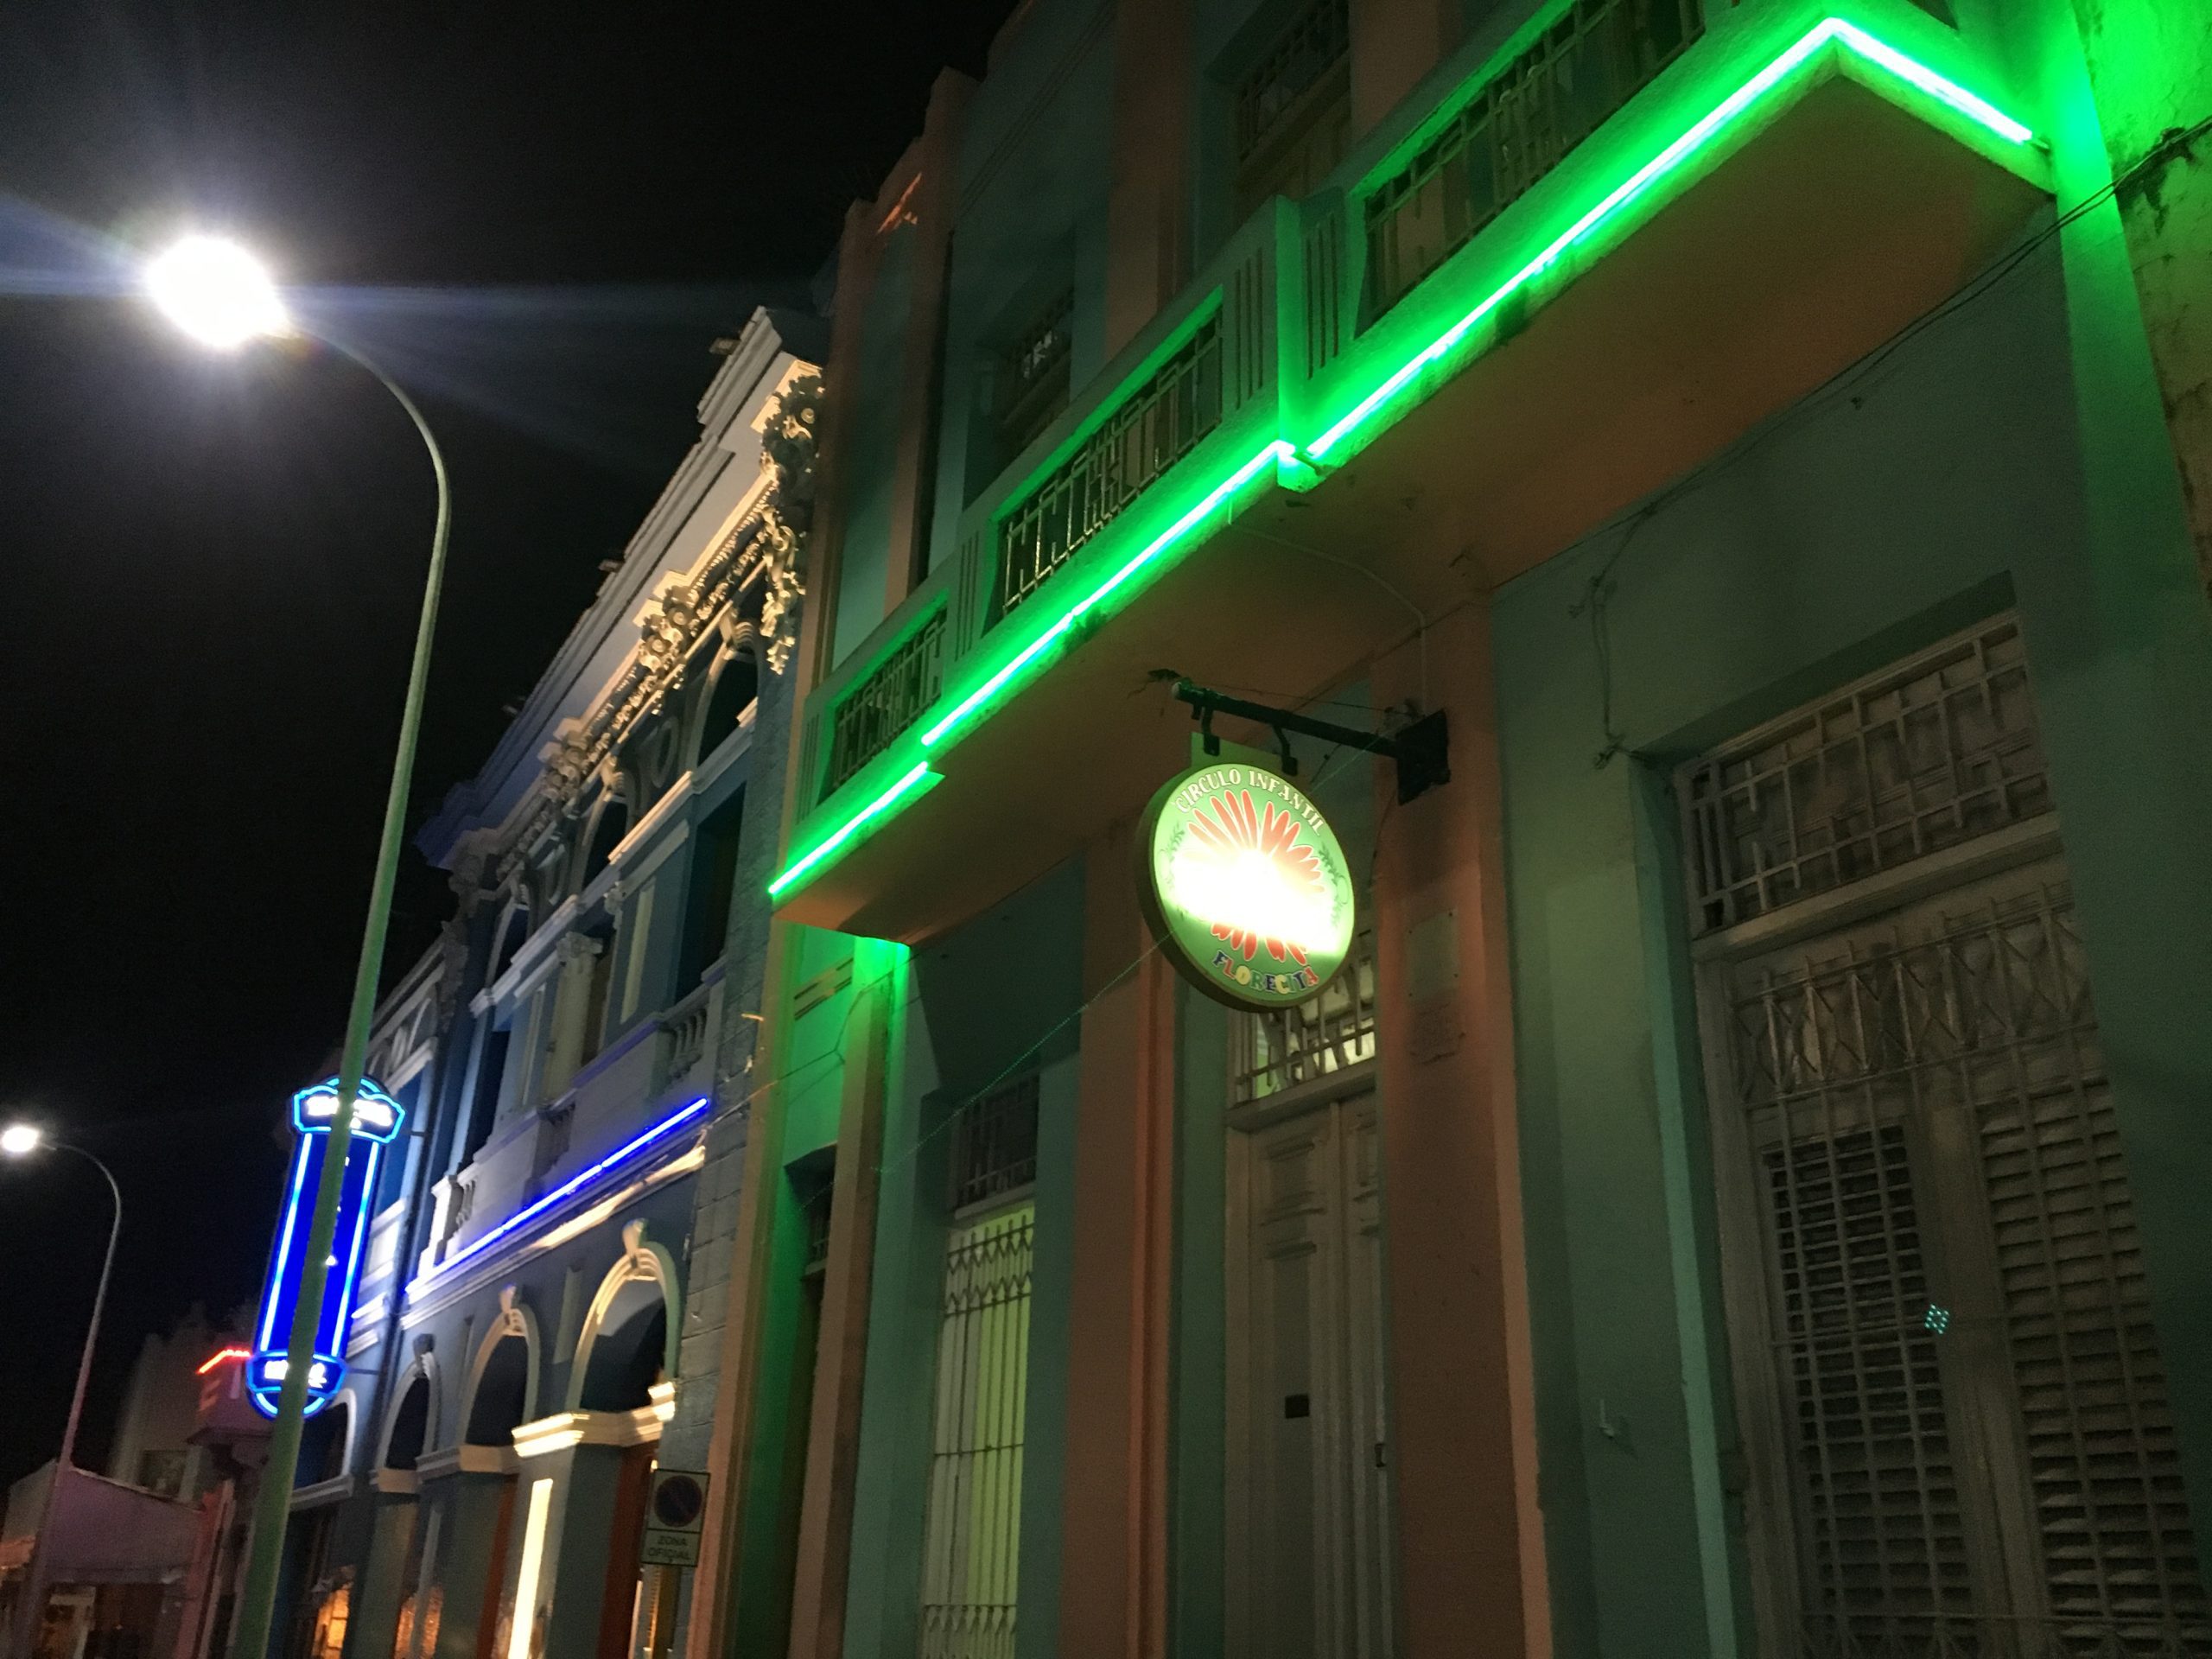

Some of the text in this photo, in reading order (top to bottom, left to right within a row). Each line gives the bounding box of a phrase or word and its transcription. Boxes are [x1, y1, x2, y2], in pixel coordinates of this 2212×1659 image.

[1175, 768, 1326, 836] CIRCULO INFANTIL
[1213, 950, 1319, 994] FLORECITA
[648, 1548, 691, 1560] OFICIAL
[658, 1535, 688, 1546] ZONA
